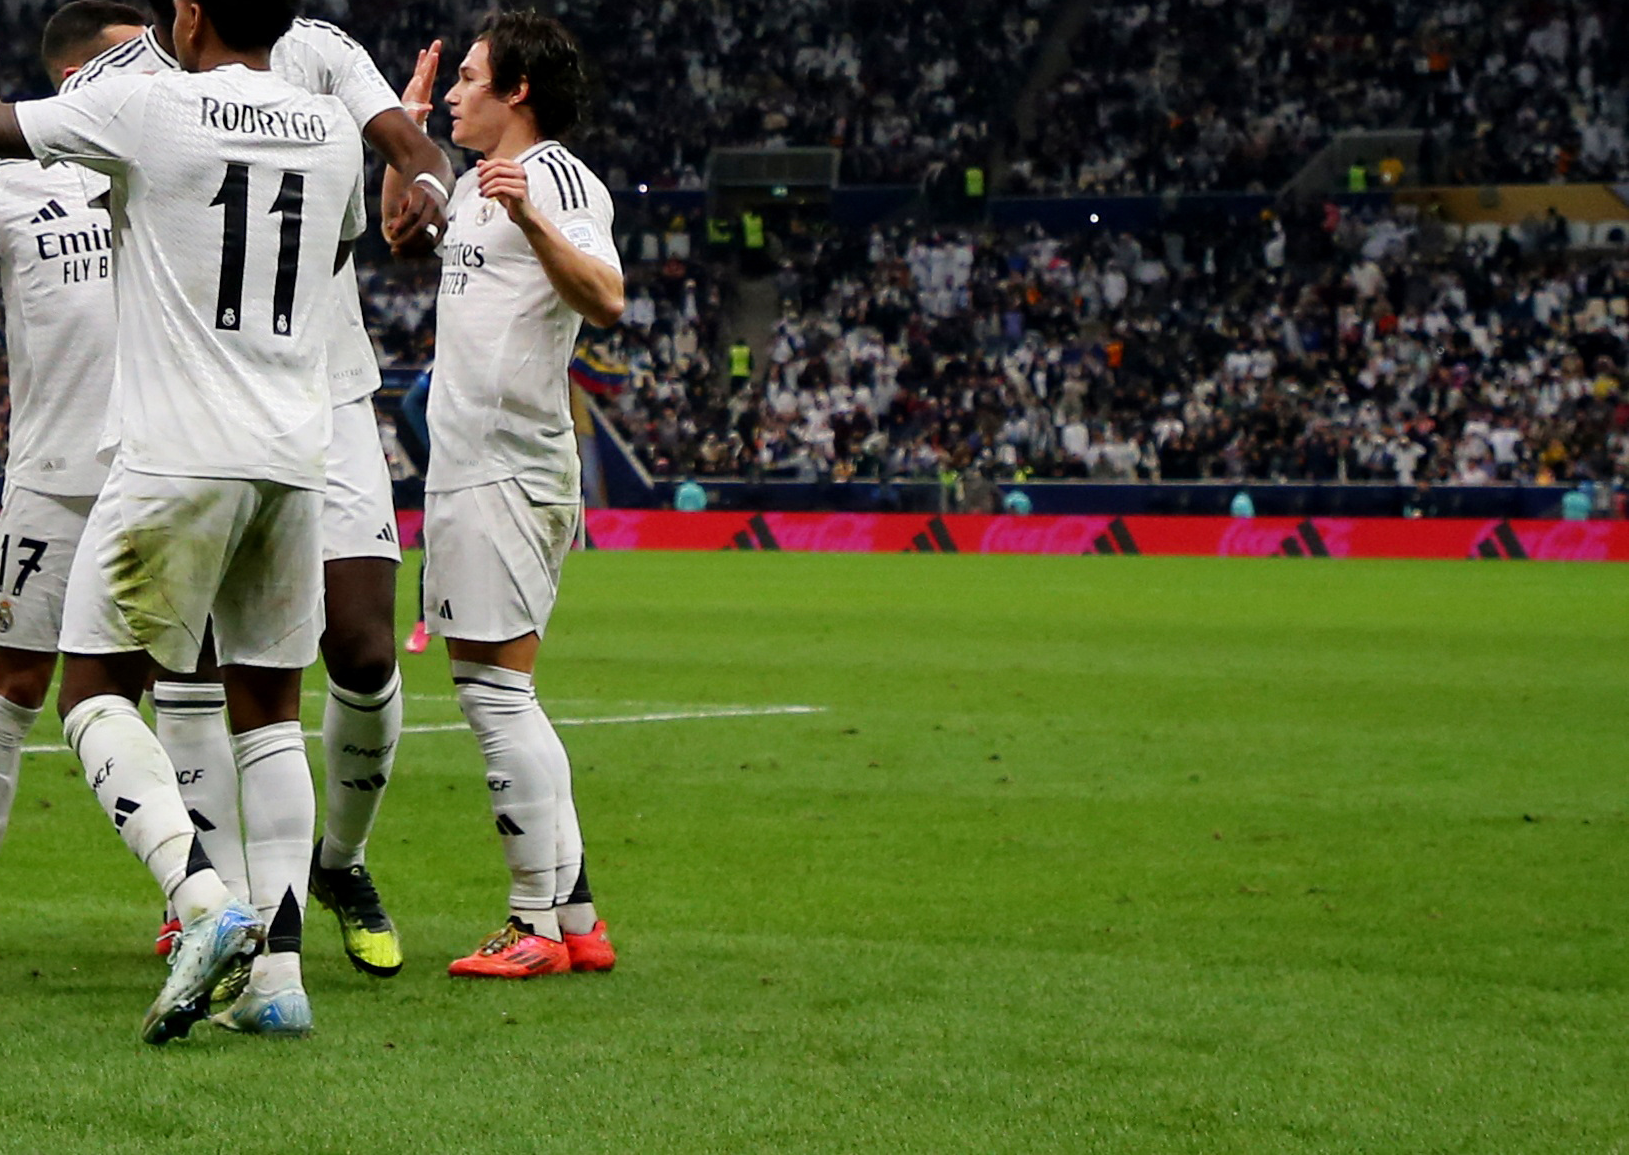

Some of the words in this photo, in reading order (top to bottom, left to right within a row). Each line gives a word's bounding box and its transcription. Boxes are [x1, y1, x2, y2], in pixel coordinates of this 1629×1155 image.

[200, 96, 327, 143] RODRYGO
[35, 223, 112, 261] Emir
[209, 162, 305, 337] 11
[63, 257, 91, 285] FLY
